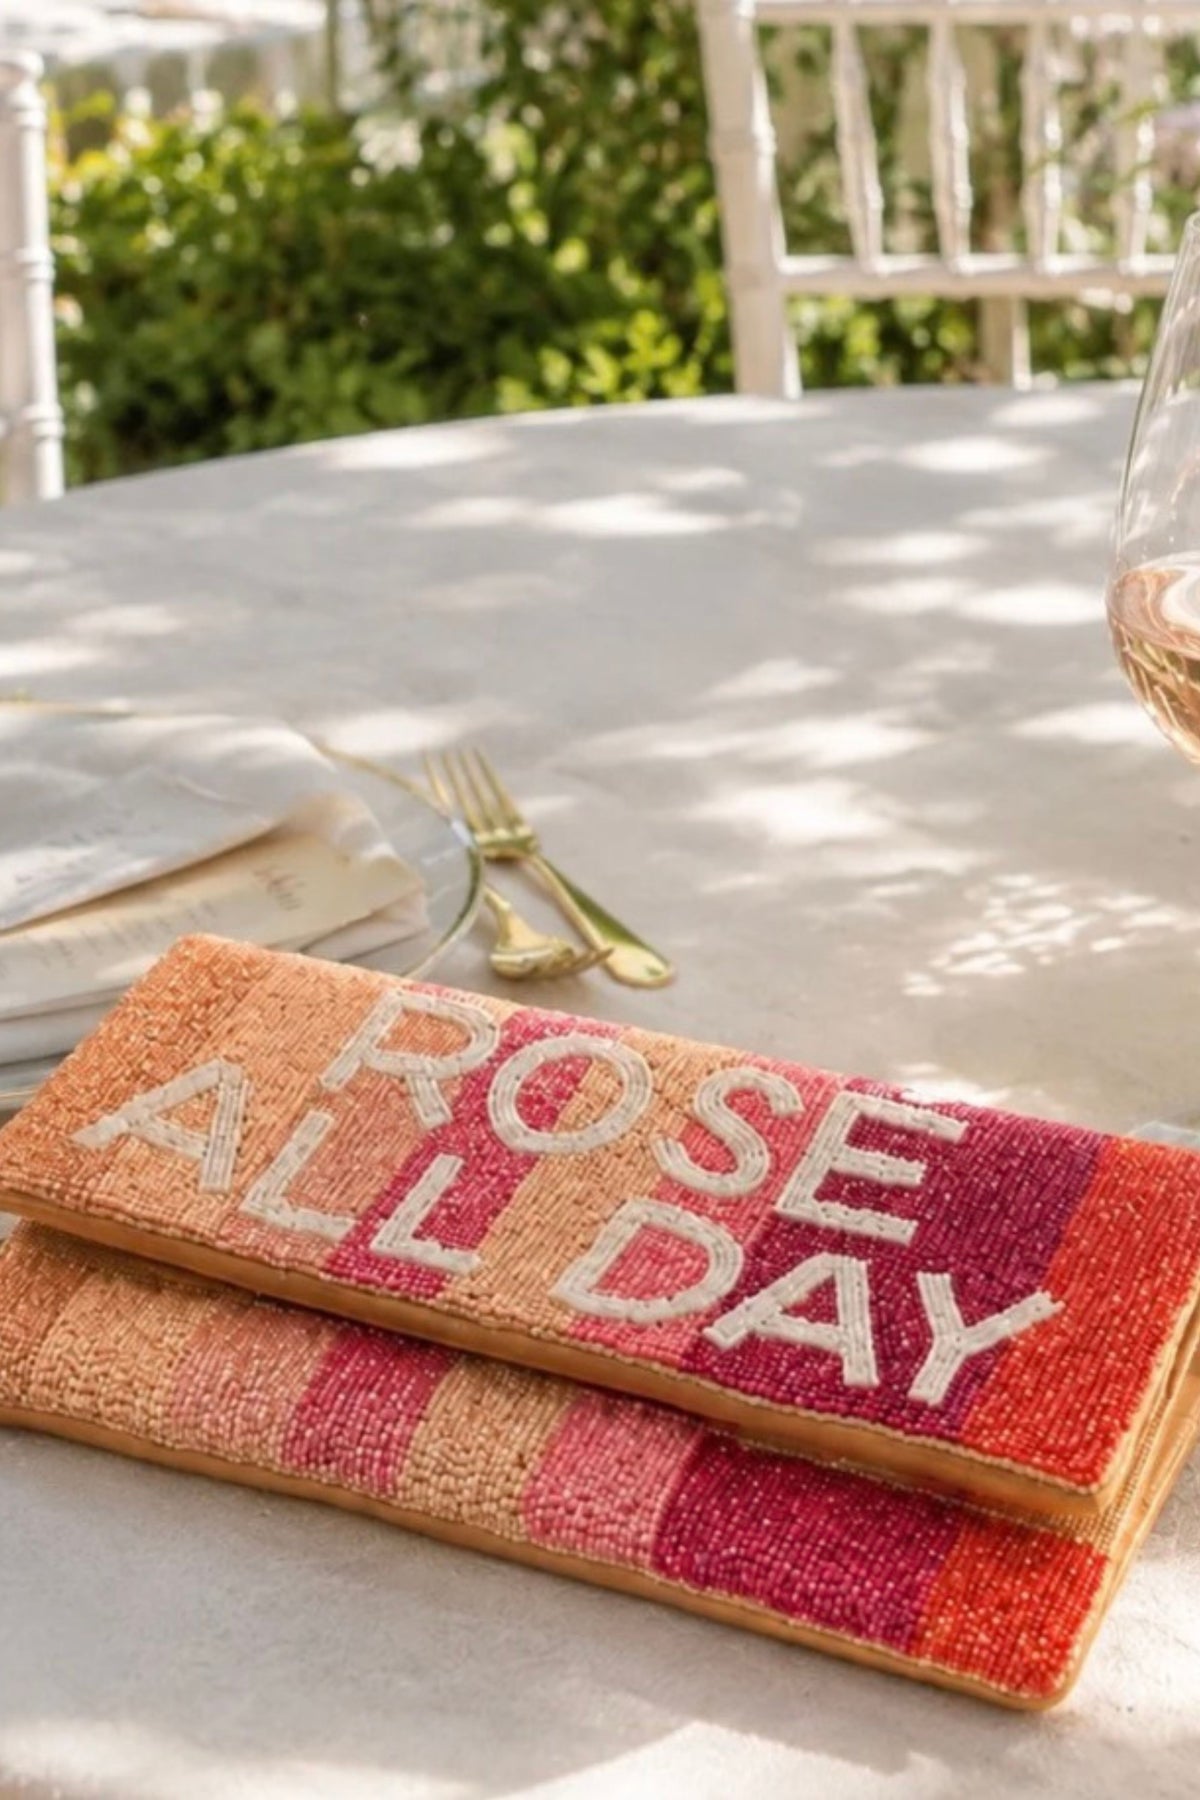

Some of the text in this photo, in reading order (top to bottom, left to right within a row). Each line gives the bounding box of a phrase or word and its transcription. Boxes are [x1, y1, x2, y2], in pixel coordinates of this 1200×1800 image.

[73, 1060, 1064, 1404] ALL DAY
[321, 991, 967, 1245] ROSE
